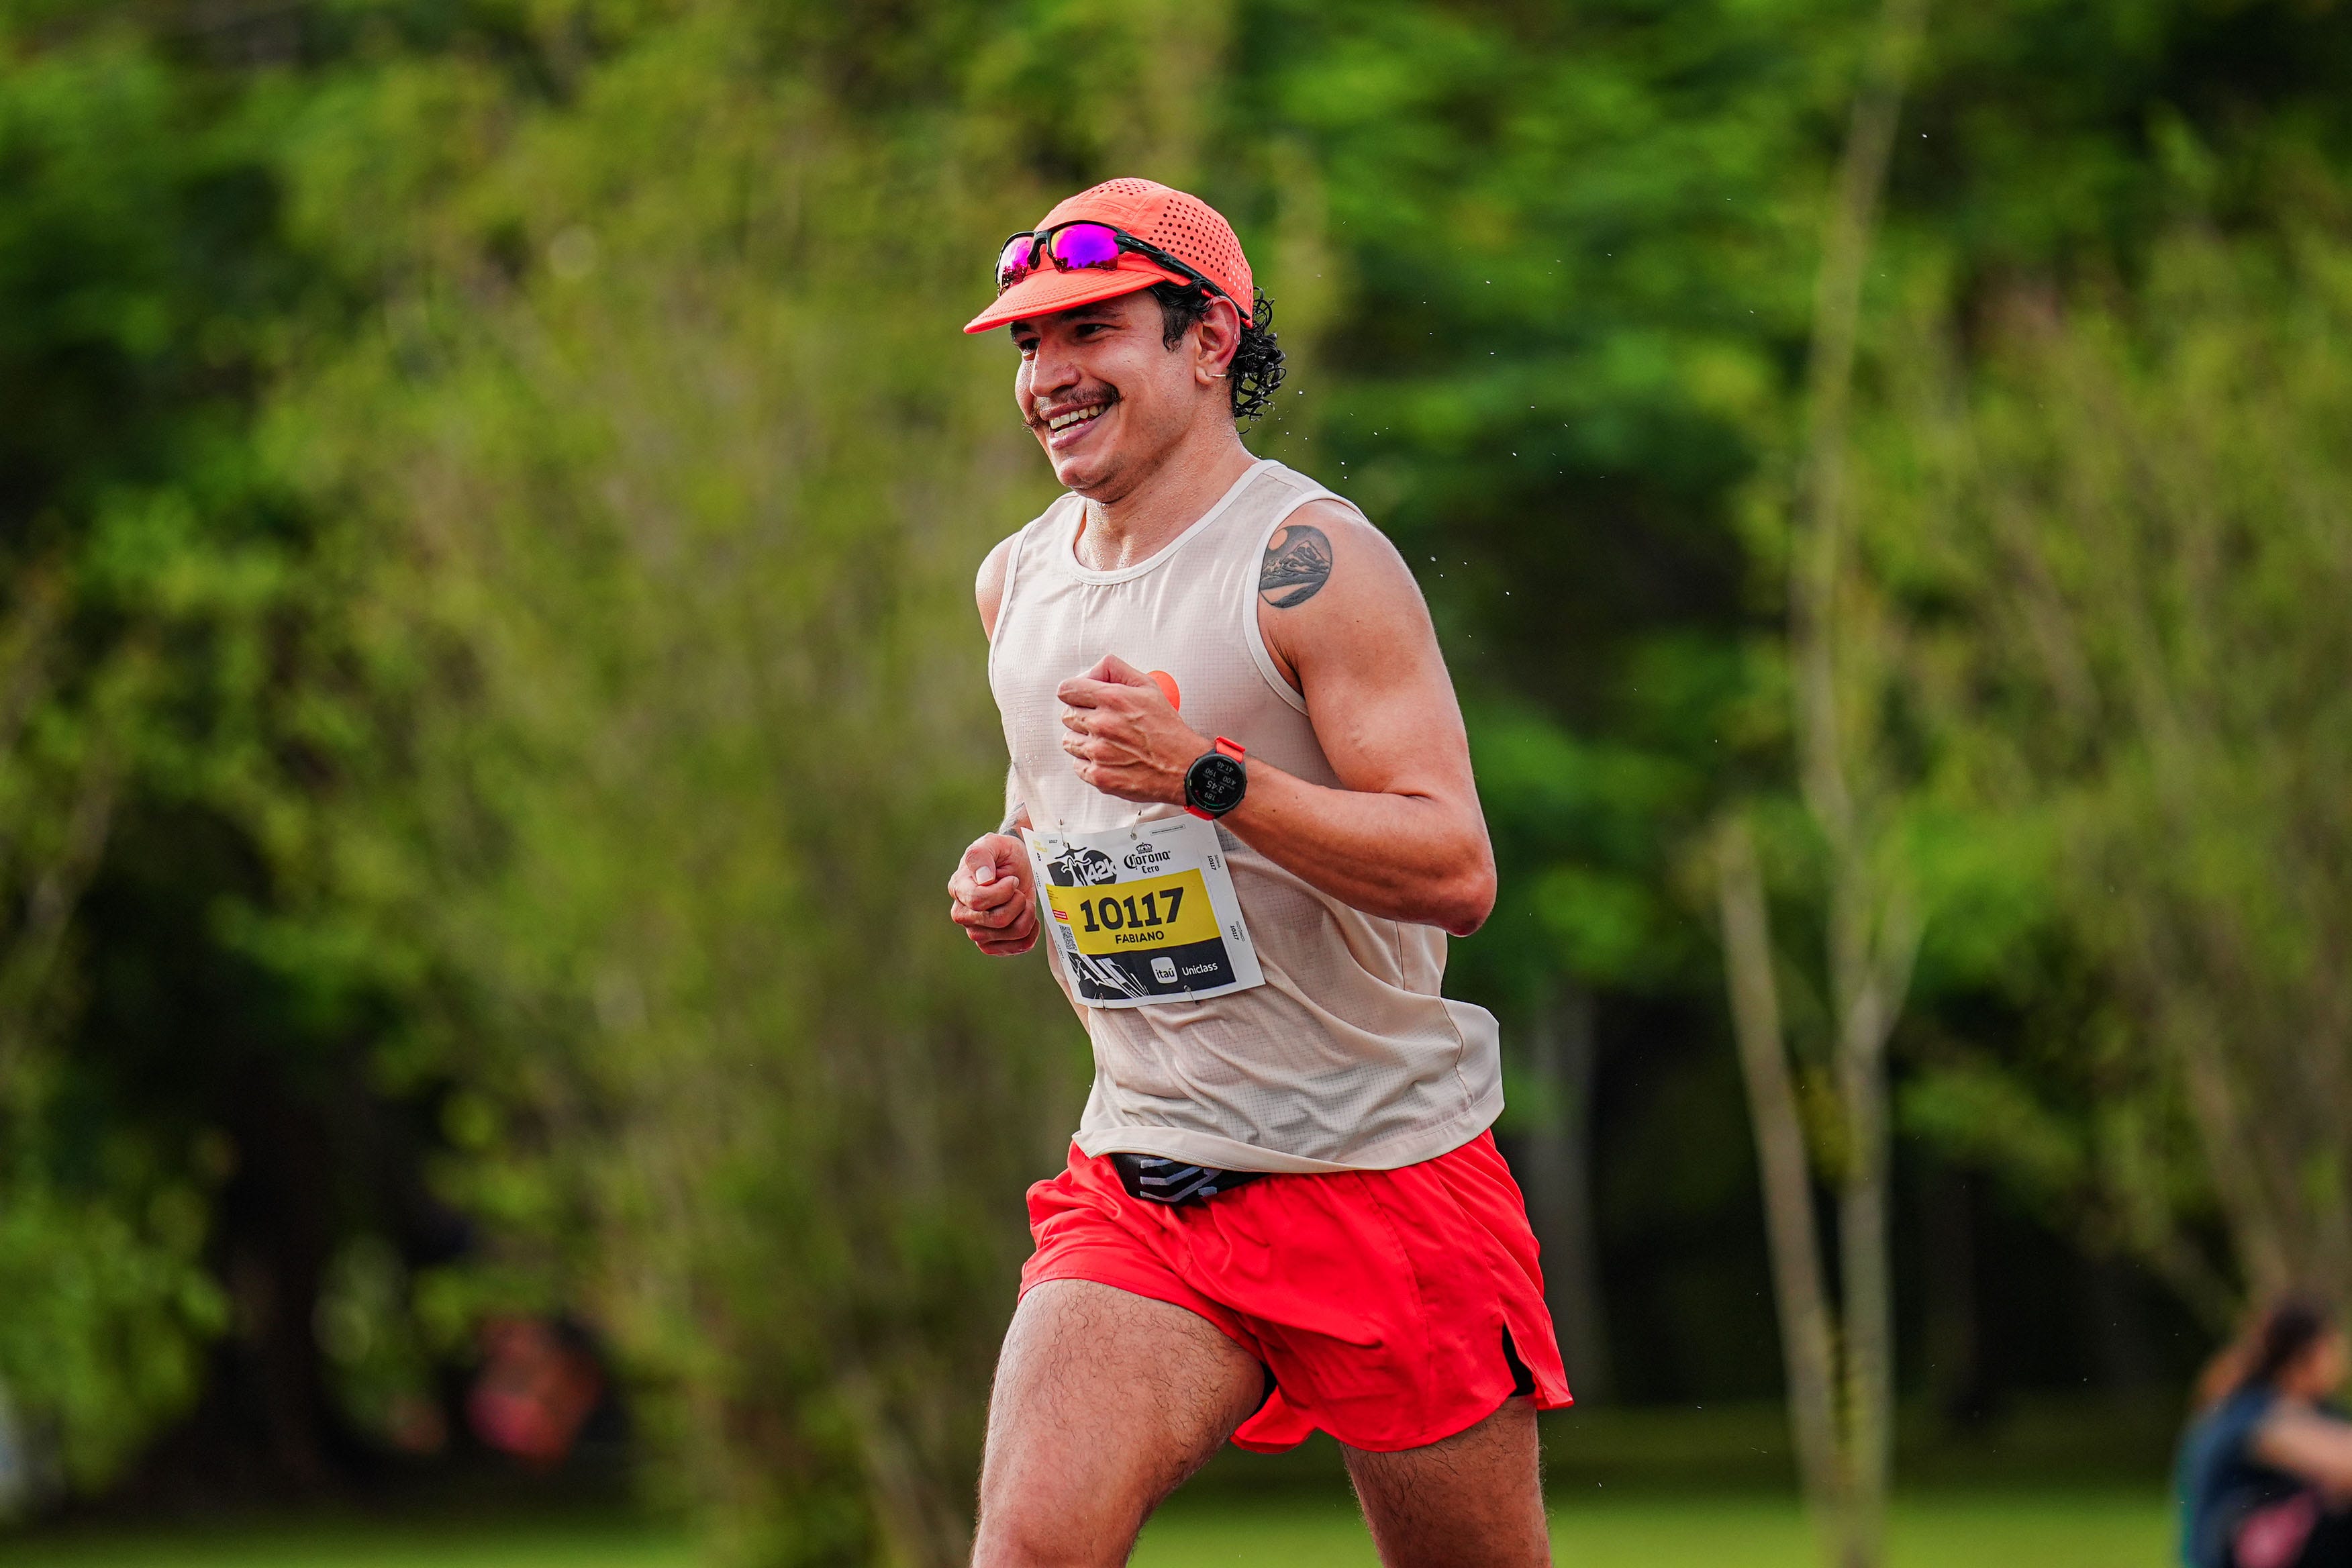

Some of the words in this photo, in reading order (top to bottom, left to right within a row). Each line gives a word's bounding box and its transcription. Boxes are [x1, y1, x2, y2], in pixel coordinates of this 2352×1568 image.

[1206, 781, 1225, 793] 3:45
[1124, 850, 1171, 871] Corona
[1208, 855, 1217, 871] 10117
[1142, 865, 1160, 874] Cero
[1080, 886, 1184, 932] 10117
[1115, 930, 1165, 944] FABIANO
[1230, 925, 1240, 940] 10117
[1155, 967, 1175, 979] itaú
[1181, 962, 1218, 976] Uniclass
